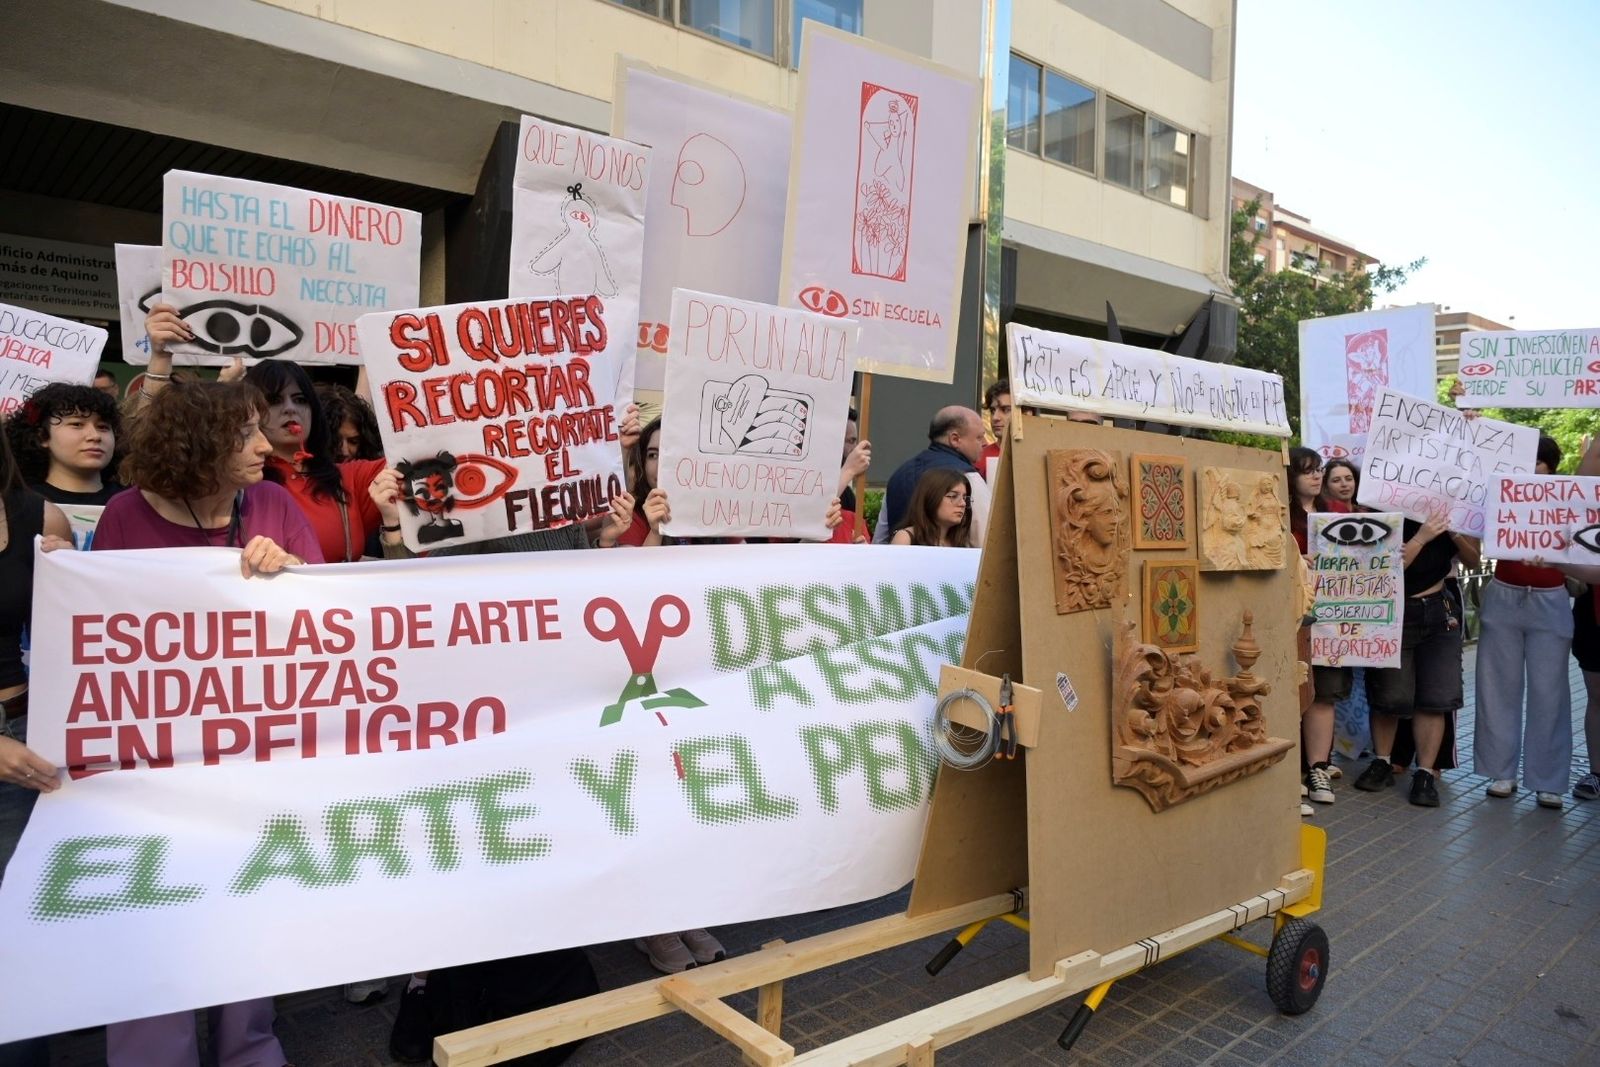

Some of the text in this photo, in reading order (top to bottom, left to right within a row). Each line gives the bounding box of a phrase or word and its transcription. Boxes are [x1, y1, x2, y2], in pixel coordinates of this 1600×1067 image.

[524, 125, 646, 191] QUE NO NOS
[182, 186, 402, 245] HASTA EL DINERO
[169, 220, 356, 274] QUE TE ECHAS AL
[30, 264, 48, 277] de
[51, 267, 99, 282] Aquino
[52, 284, 112, 299] Territoriales
[172, 259, 275, 297] BOLSILLO
[41, 295, 91, 308] Generales
[300, 277, 387, 308] NECESITA
[852, 299, 942, 329] SIN ESCUELA
[390, 295, 608, 373] SI QUIERES
[685, 299, 848, 383] POR UN AULA
[1467, 337, 1499, 359] SIN
[1504, 332, 1571, 357] INVERSIÓN
[1572, 335, 1588, 356] EN
[384, 359, 595, 432] RECORTAR
[1069, 359, 1092, 400] ES
[1149, 369, 1162, 407] Y
[1464, 379, 1508, 396] PIERDE
[1526, 380, 1546, 397] SU
[483, 405, 618, 458] RECORTATE
[1378, 393, 1515, 455] ENSEÑANZA
[545, 449, 580, 482] EL
[1372, 425, 1483, 478] ARTÍSTICA
[675, 457, 825, 496] QUE NO PAREZCA
[1500, 479, 1585, 503] RECORTA
[702, 498, 792, 528] UNA LATA
[1498, 509, 1517, 524] LA
[1529, 507, 1580, 526] LINEA
[1497, 528, 1566, 551] PUNTOS
[1313, 553, 1390, 572] TIERRA DE
[1314, 605, 1384, 619] GOBIERNO
[1340, 623, 1360, 636] DE
[71, 599, 562, 665] ESCUELAS DE ARTE
[66, 656, 399, 724] ANDALUZAS
[64, 722, 174, 780] EN
[28, 834, 206, 925] EL
[225, 767, 553, 897] ARTE
[567, 746, 639, 837] Y
[670, 732, 800, 826] EL
